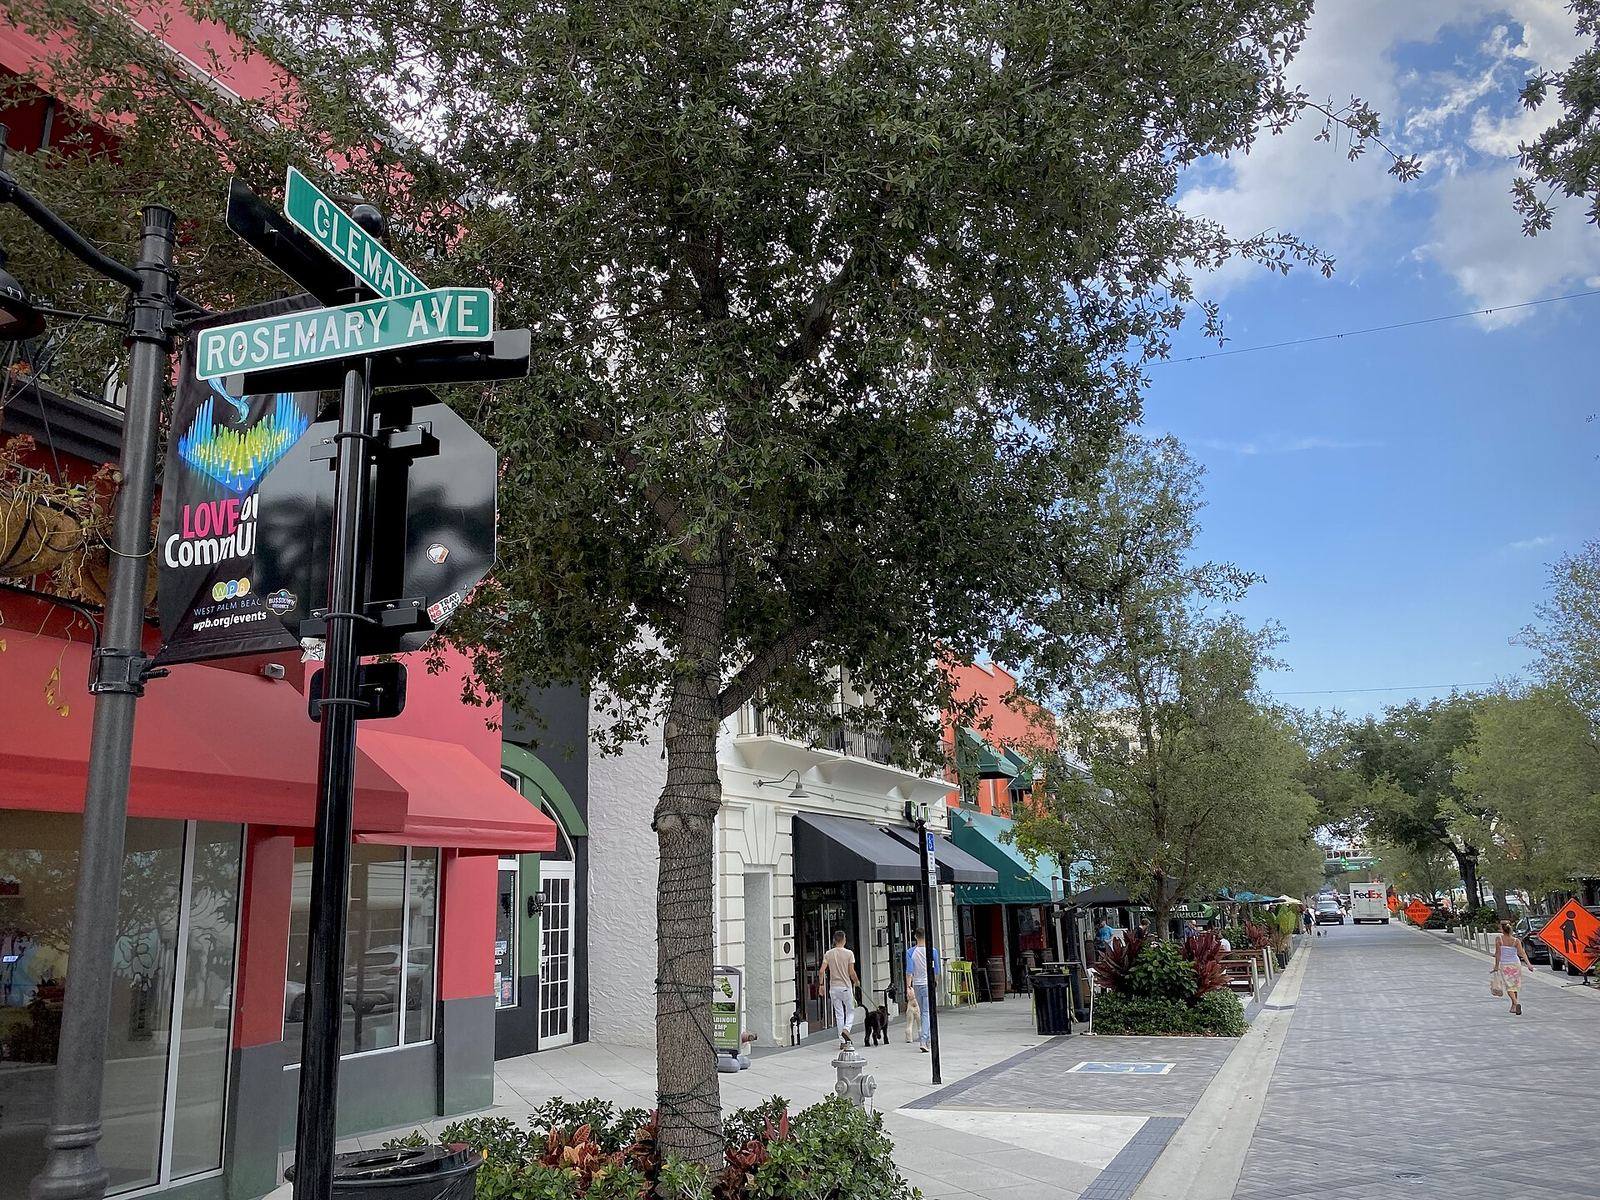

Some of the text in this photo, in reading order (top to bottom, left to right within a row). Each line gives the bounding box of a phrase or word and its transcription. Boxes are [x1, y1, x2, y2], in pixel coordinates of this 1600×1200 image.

[206, 295, 479, 371] ROSEMARY AVE
[182, 499, 240, 539] LOVE
[164, 521, 258, 568] CommU
[193, 605, 216, 617] WEST
[216, 601, 238, 612] PALM
[240, 598, 262, 608] BEAC
[427, 604, 440, 614] NO
[430, 609, 442, 619] NO
[192, 610, 268, 632] wpb.org/events
[1353, 889, 1383, 899] FedEx
